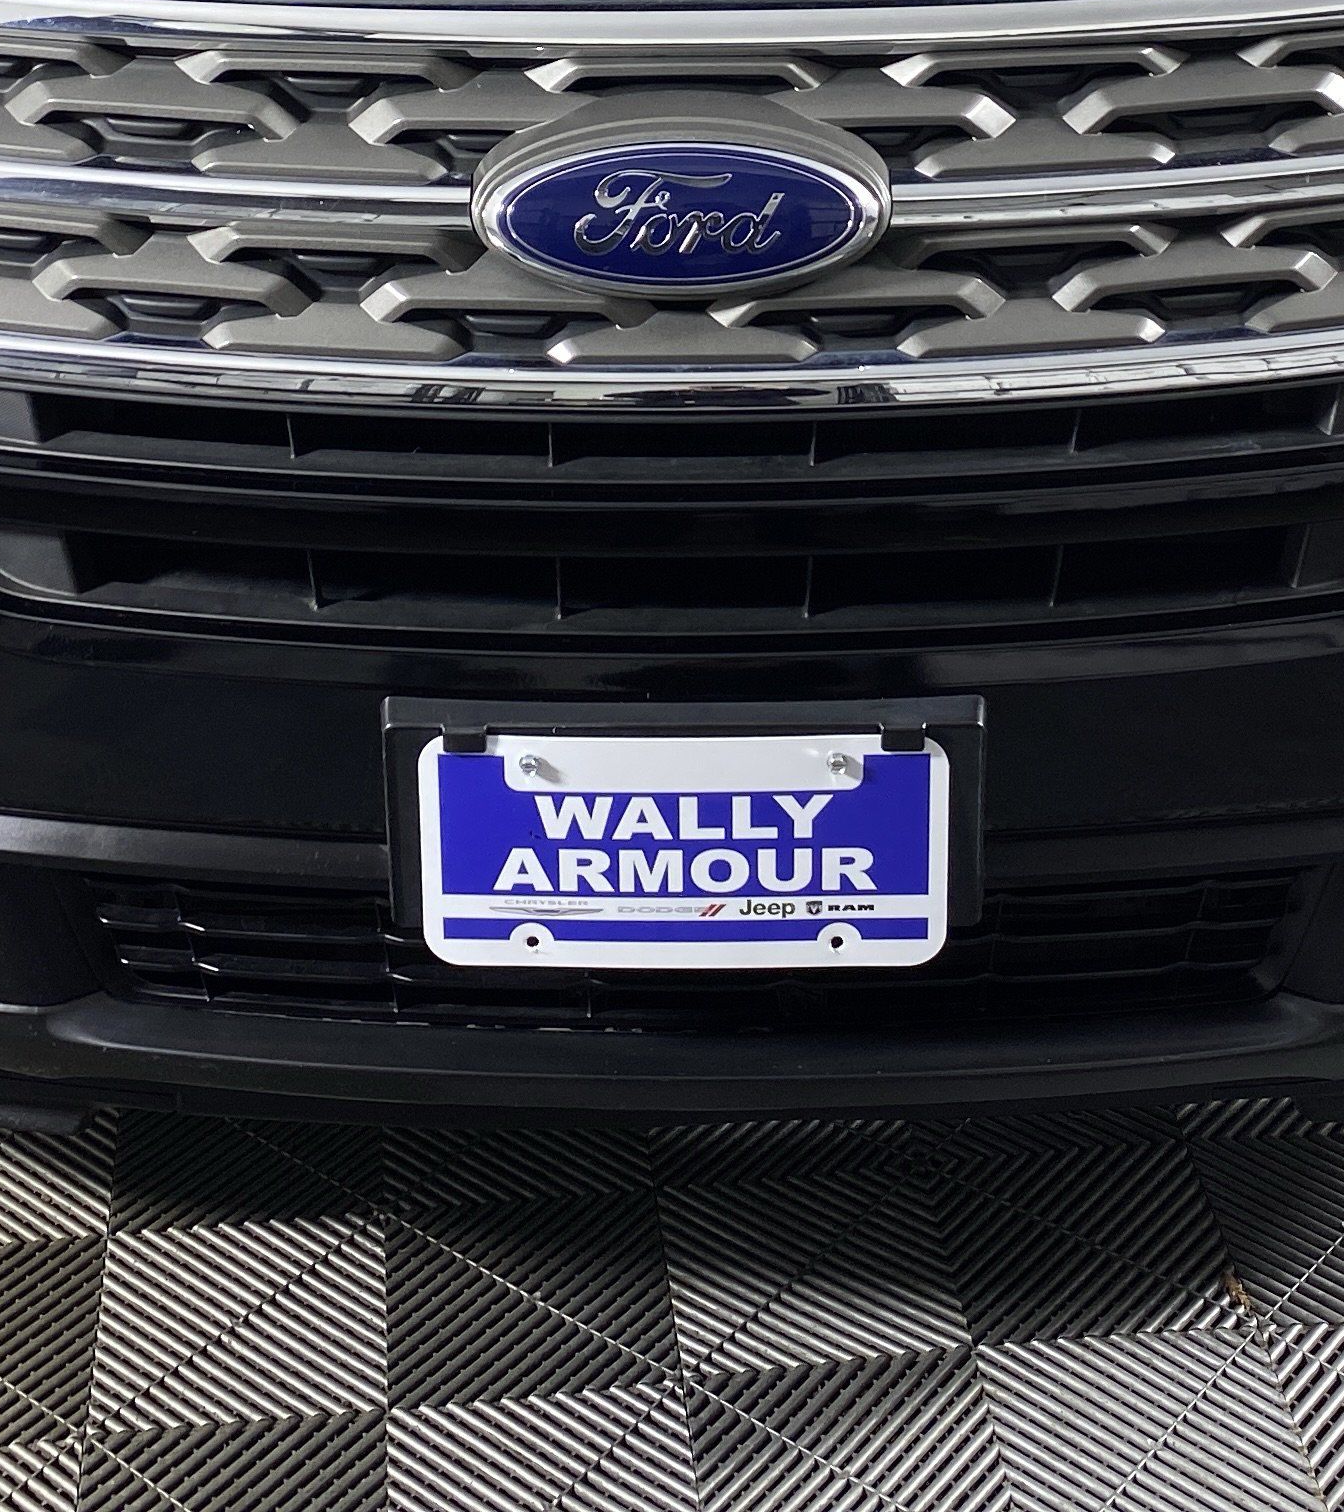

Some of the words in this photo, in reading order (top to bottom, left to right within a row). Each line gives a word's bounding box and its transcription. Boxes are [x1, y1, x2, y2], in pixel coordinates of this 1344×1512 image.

[573, 169, 786, 256] Ford
[534, 794, 833, 841] WALLY
[492, 847, 879, 893] ARMOUR
[617, 906, 708, 914] DODGE
[739, 899, 796, 918] Jeep
[827, 904, 875, 912] RAM
